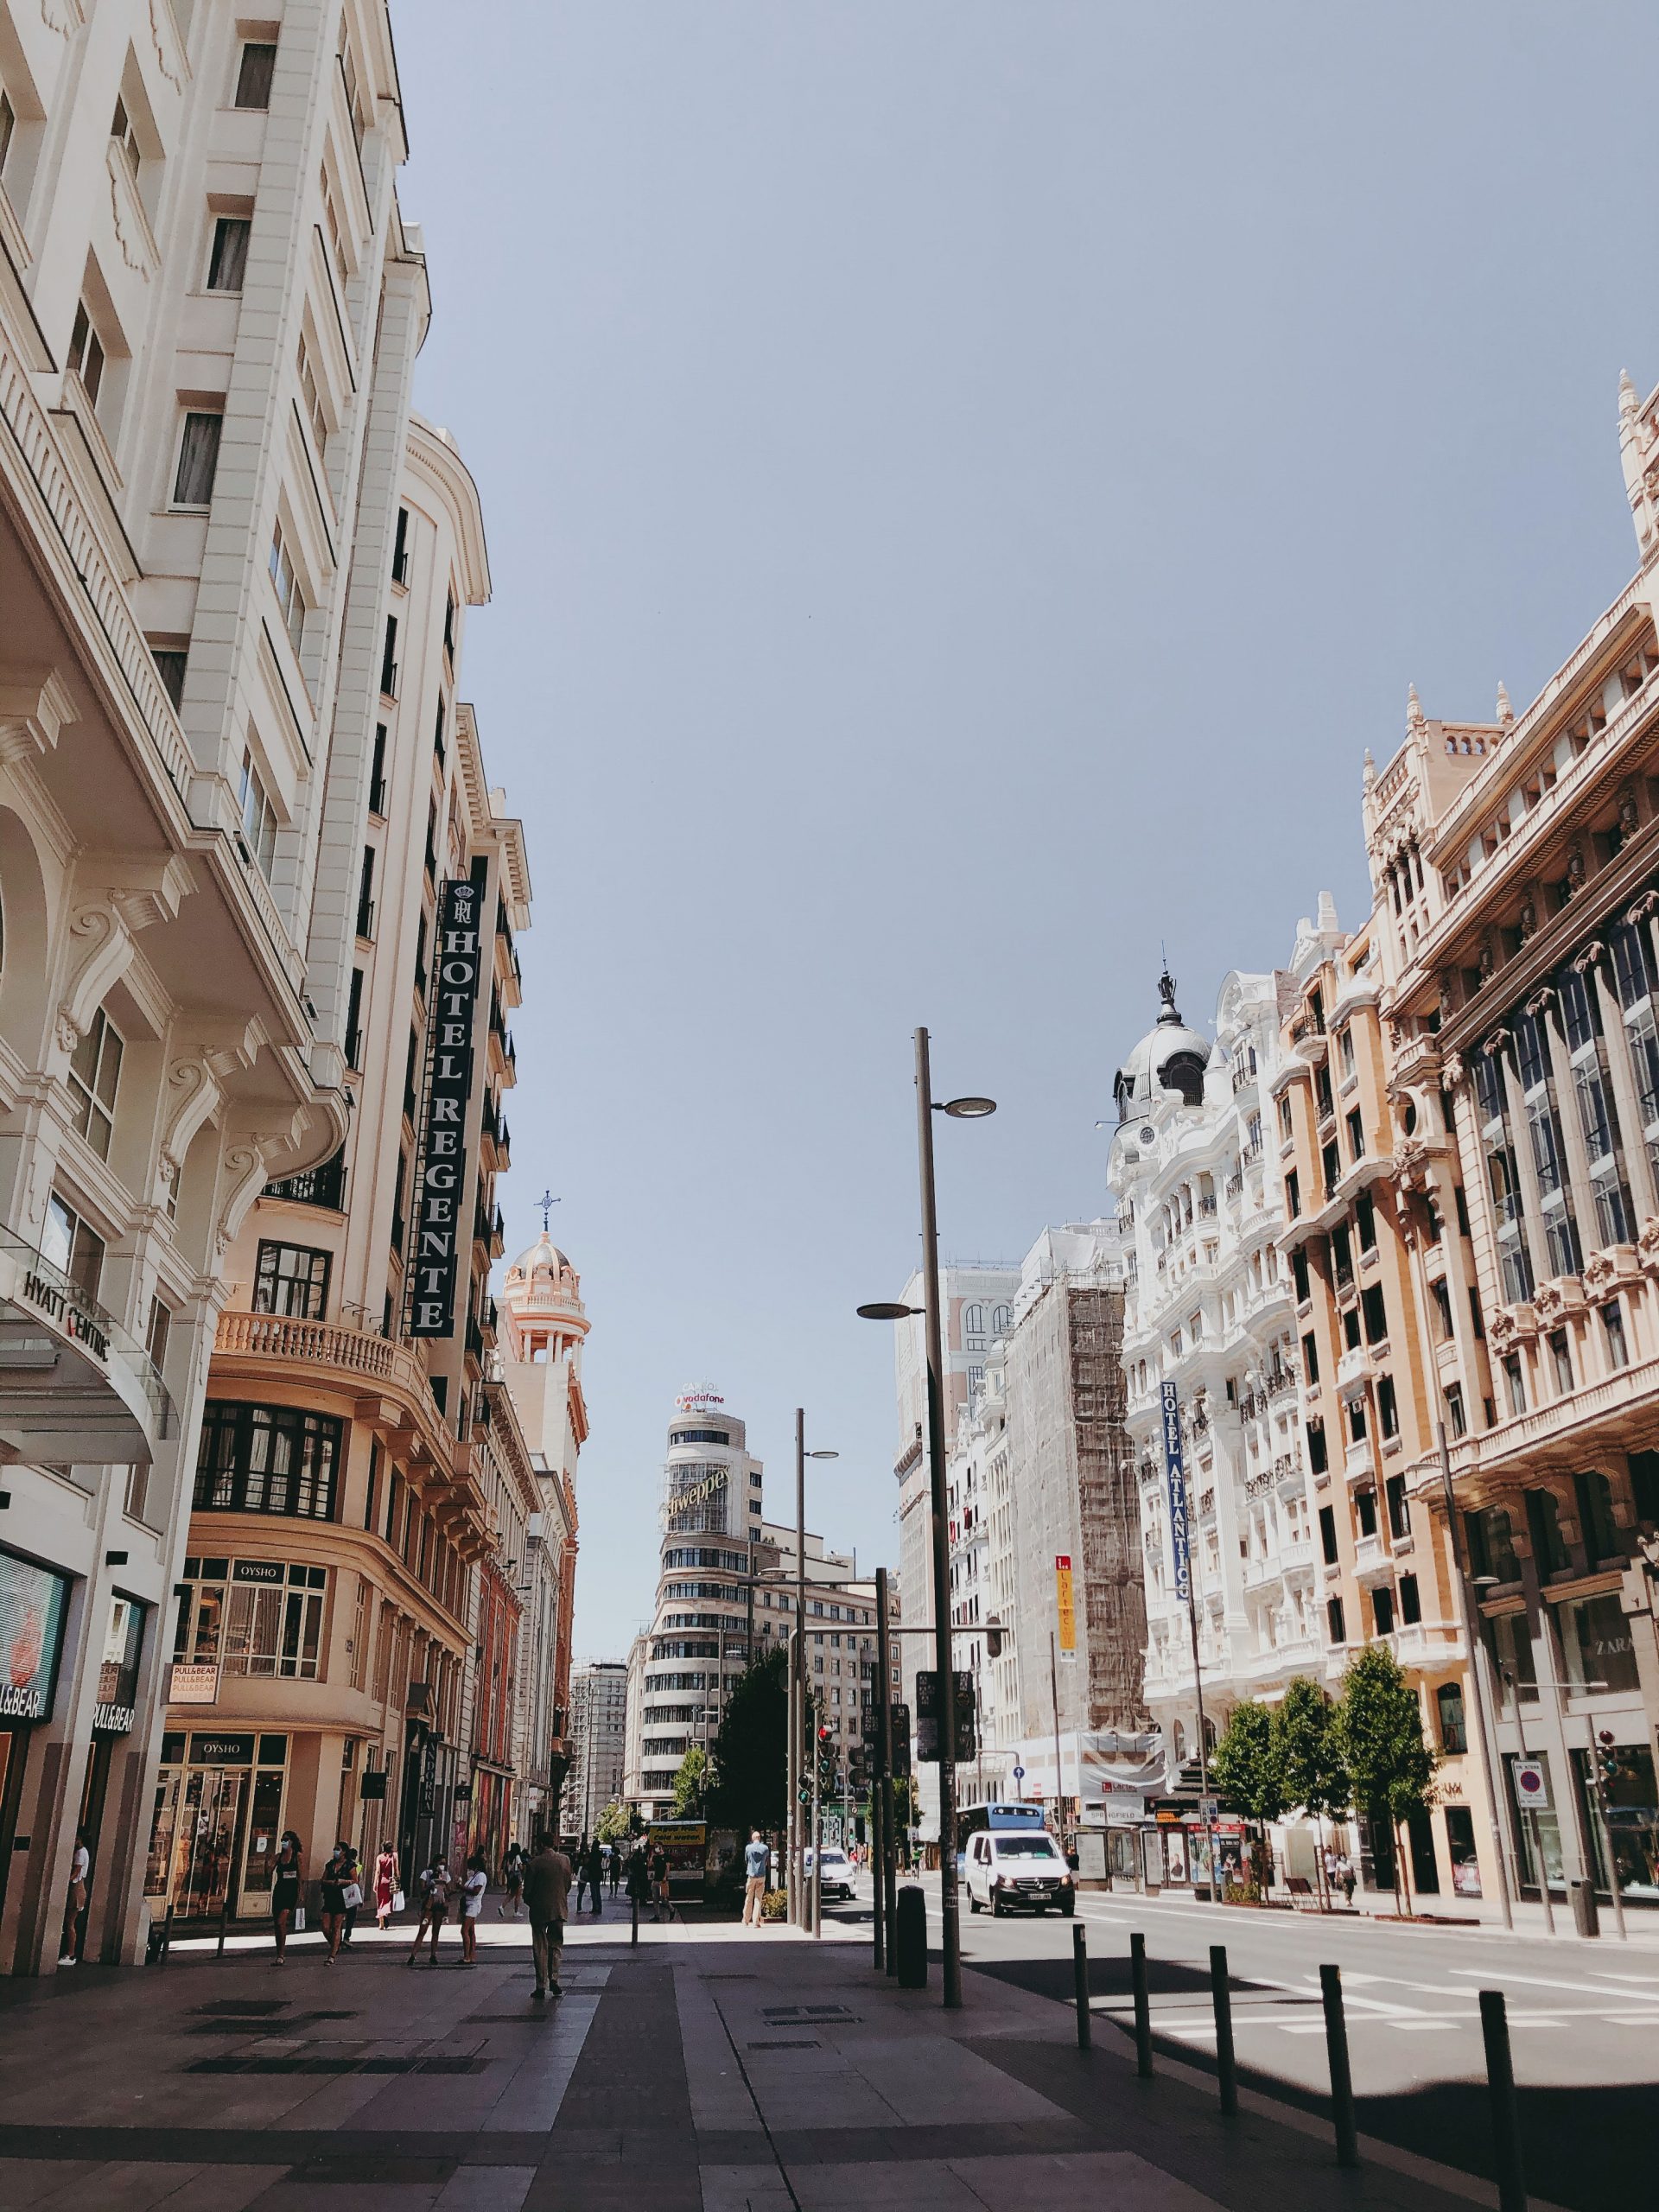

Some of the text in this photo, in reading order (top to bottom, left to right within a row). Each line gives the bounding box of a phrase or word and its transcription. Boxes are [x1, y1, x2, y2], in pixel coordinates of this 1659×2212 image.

[416, 931, 477, 1328] HOTEL REGENTE
[23, 1271, 111, 1362] HYATT CENTRIC
[683, 1393, 725, 1404] vodafone
[1162, 1384, 1190, 1599] HOTEL ATLANTICO
[240, 1567, 276, 1578] OYSHO
[203, 1744, 240, 1753] OYSHO
